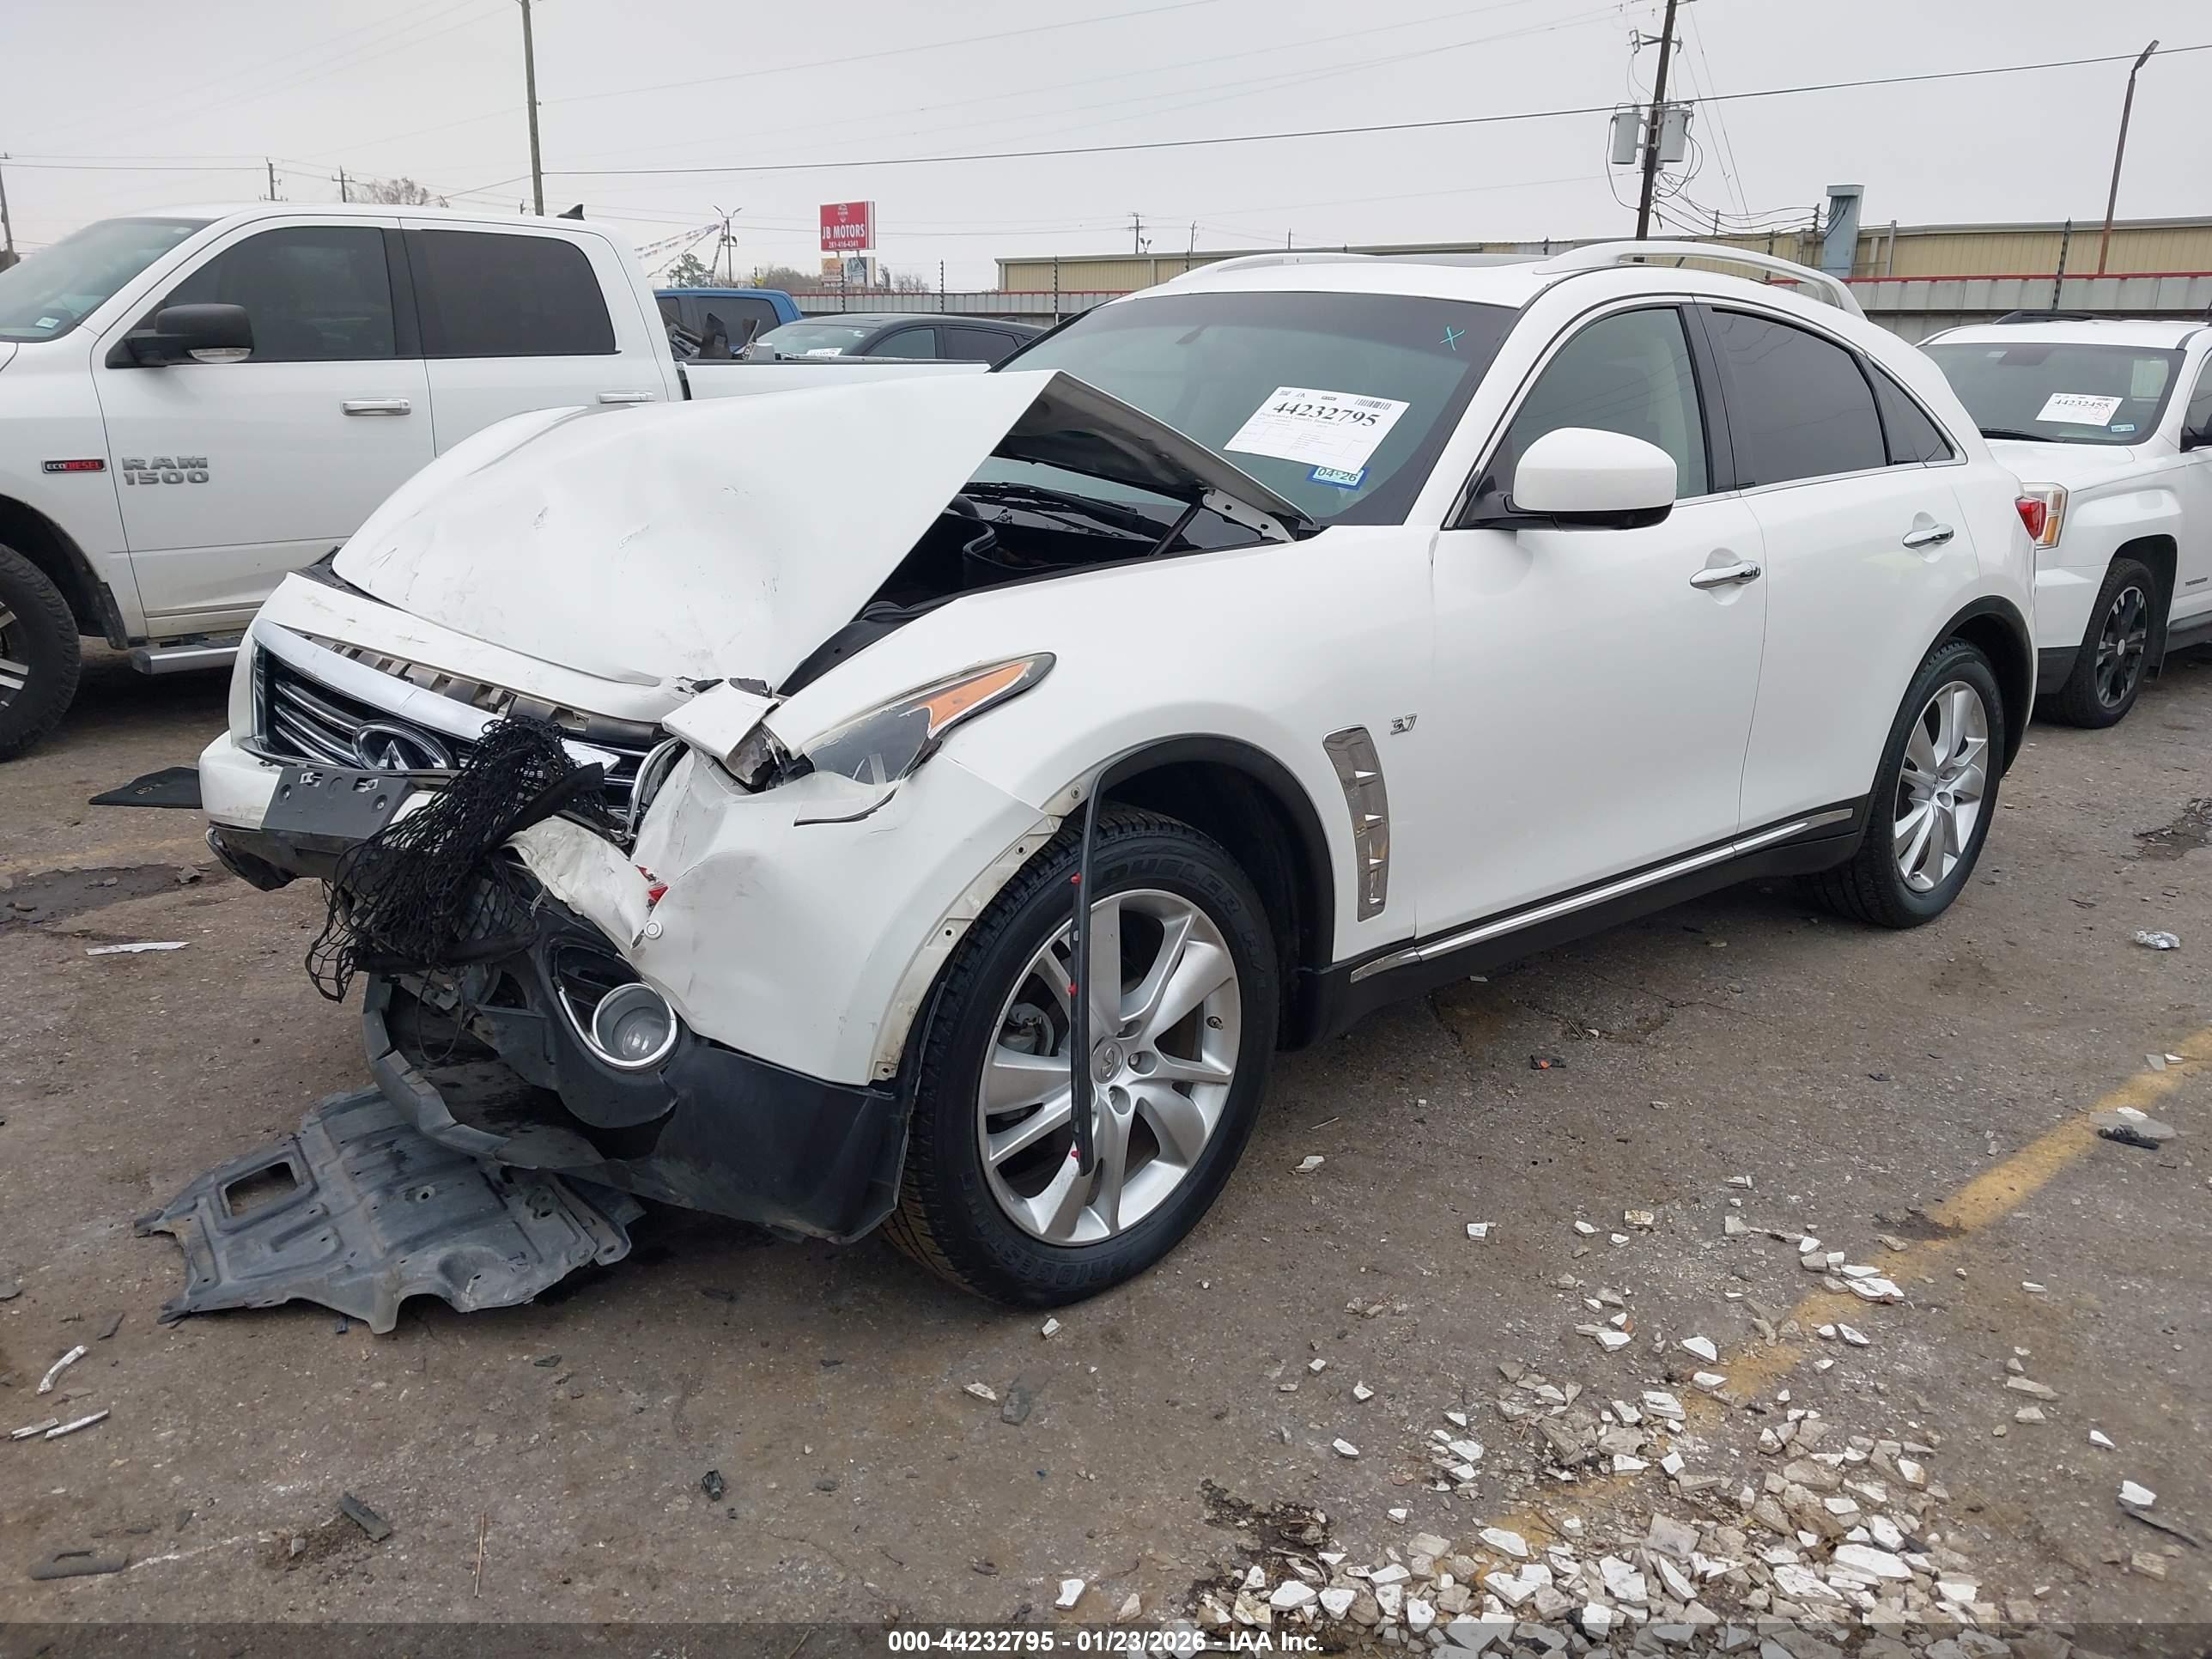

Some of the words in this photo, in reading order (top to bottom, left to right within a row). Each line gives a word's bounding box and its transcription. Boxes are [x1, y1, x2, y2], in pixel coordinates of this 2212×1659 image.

[822, 226, 831, 240] JB
[833, 223, 865, 239] MOTORS
[1273, 401, 1381, 426] 44232795
[122, 456, 208, 471] RAM
[125, 471, 209, 485] 1500
